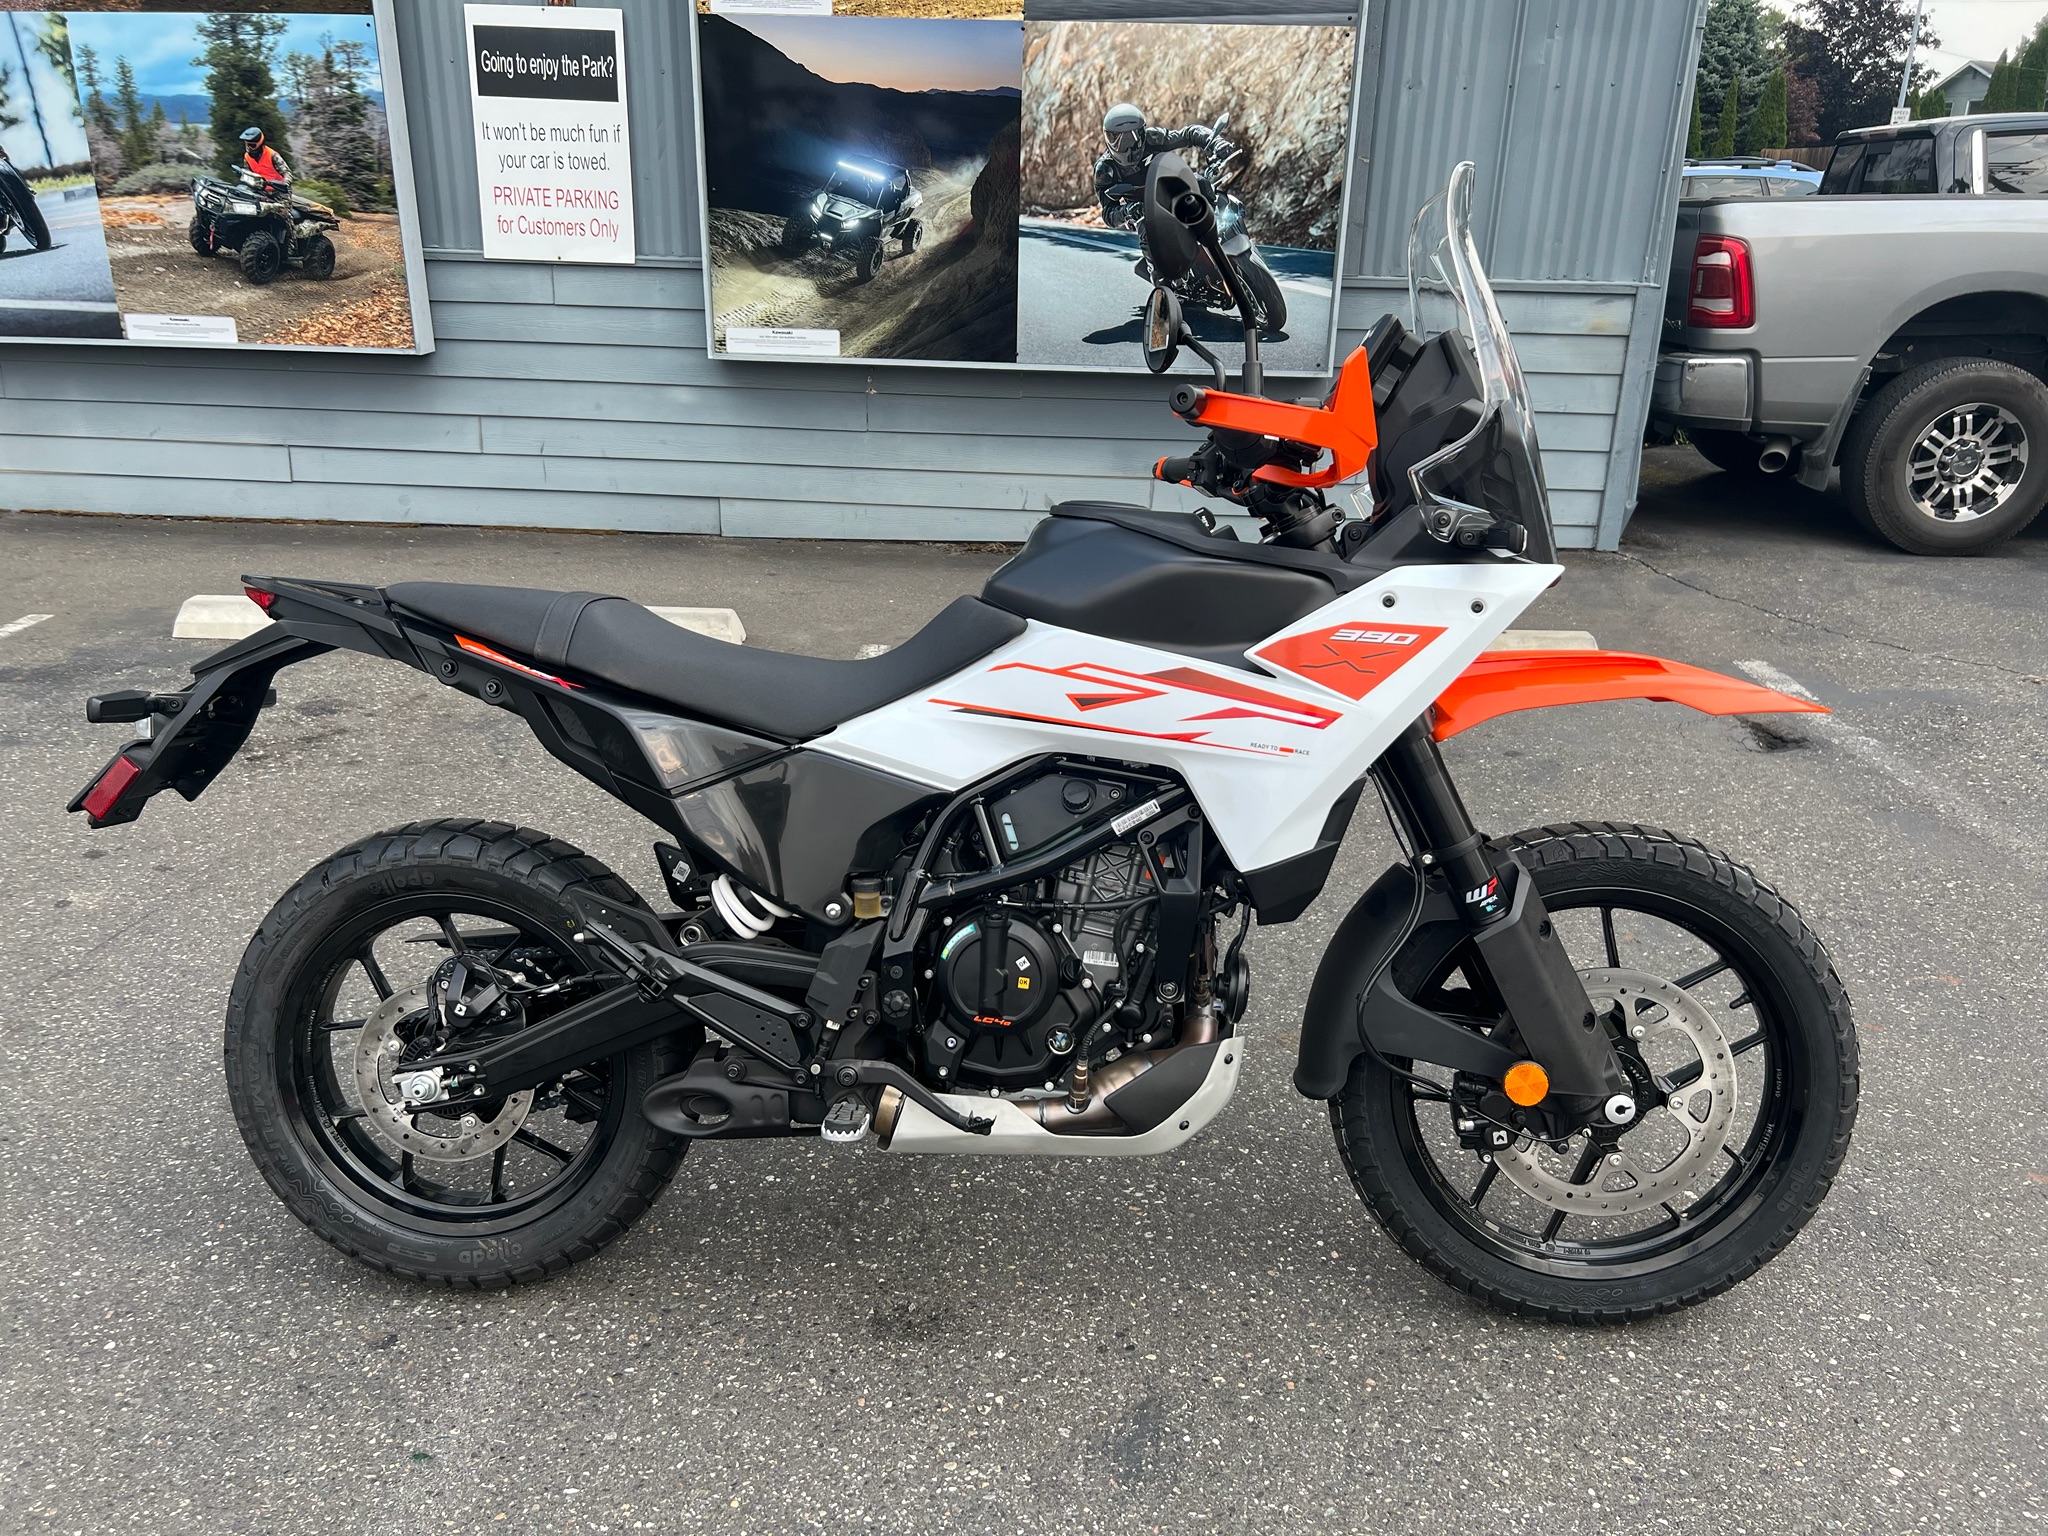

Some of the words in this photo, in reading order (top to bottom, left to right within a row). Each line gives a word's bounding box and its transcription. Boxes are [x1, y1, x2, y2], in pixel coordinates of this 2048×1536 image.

[481, 50, 514, 79] Going
[516, 52, 528, 74] to
[529, 53, 559, 81] enjoy
[561, 54, 580, 77] the
[582, 55, 614, 78] Park?
[482, 121, 491, 140] It
[493, 122, 527, 142] won't
[530, 123, 546, 142] be
[550, 124, 586, 143] much
[589, 124, 609, 143] fun
[613, 124, 621, 144] if
[499, 154, 527, 173] your
[530, 154, 550, 170] car
[553, 151, 565, 170] is
[568, 151, 610, 171] towed.
[493, 186, 552, 207] PRIVATE
[556, 188, 619, 210] PARKING
[497, 215, 514, 235] for
[518, 215, 586, 237] Customers
[590, 218, 620, 243] Only
[1329, 628, 1420, 646] 390
[1250, 742, 1270, 750] READY
[1295, 748, 1310, 756] RACE
[1465, 877, 1498, 904] WP
[1776, 1161, 1812, 1213] apollo
[458, 1238, 523, 1269] apollo
